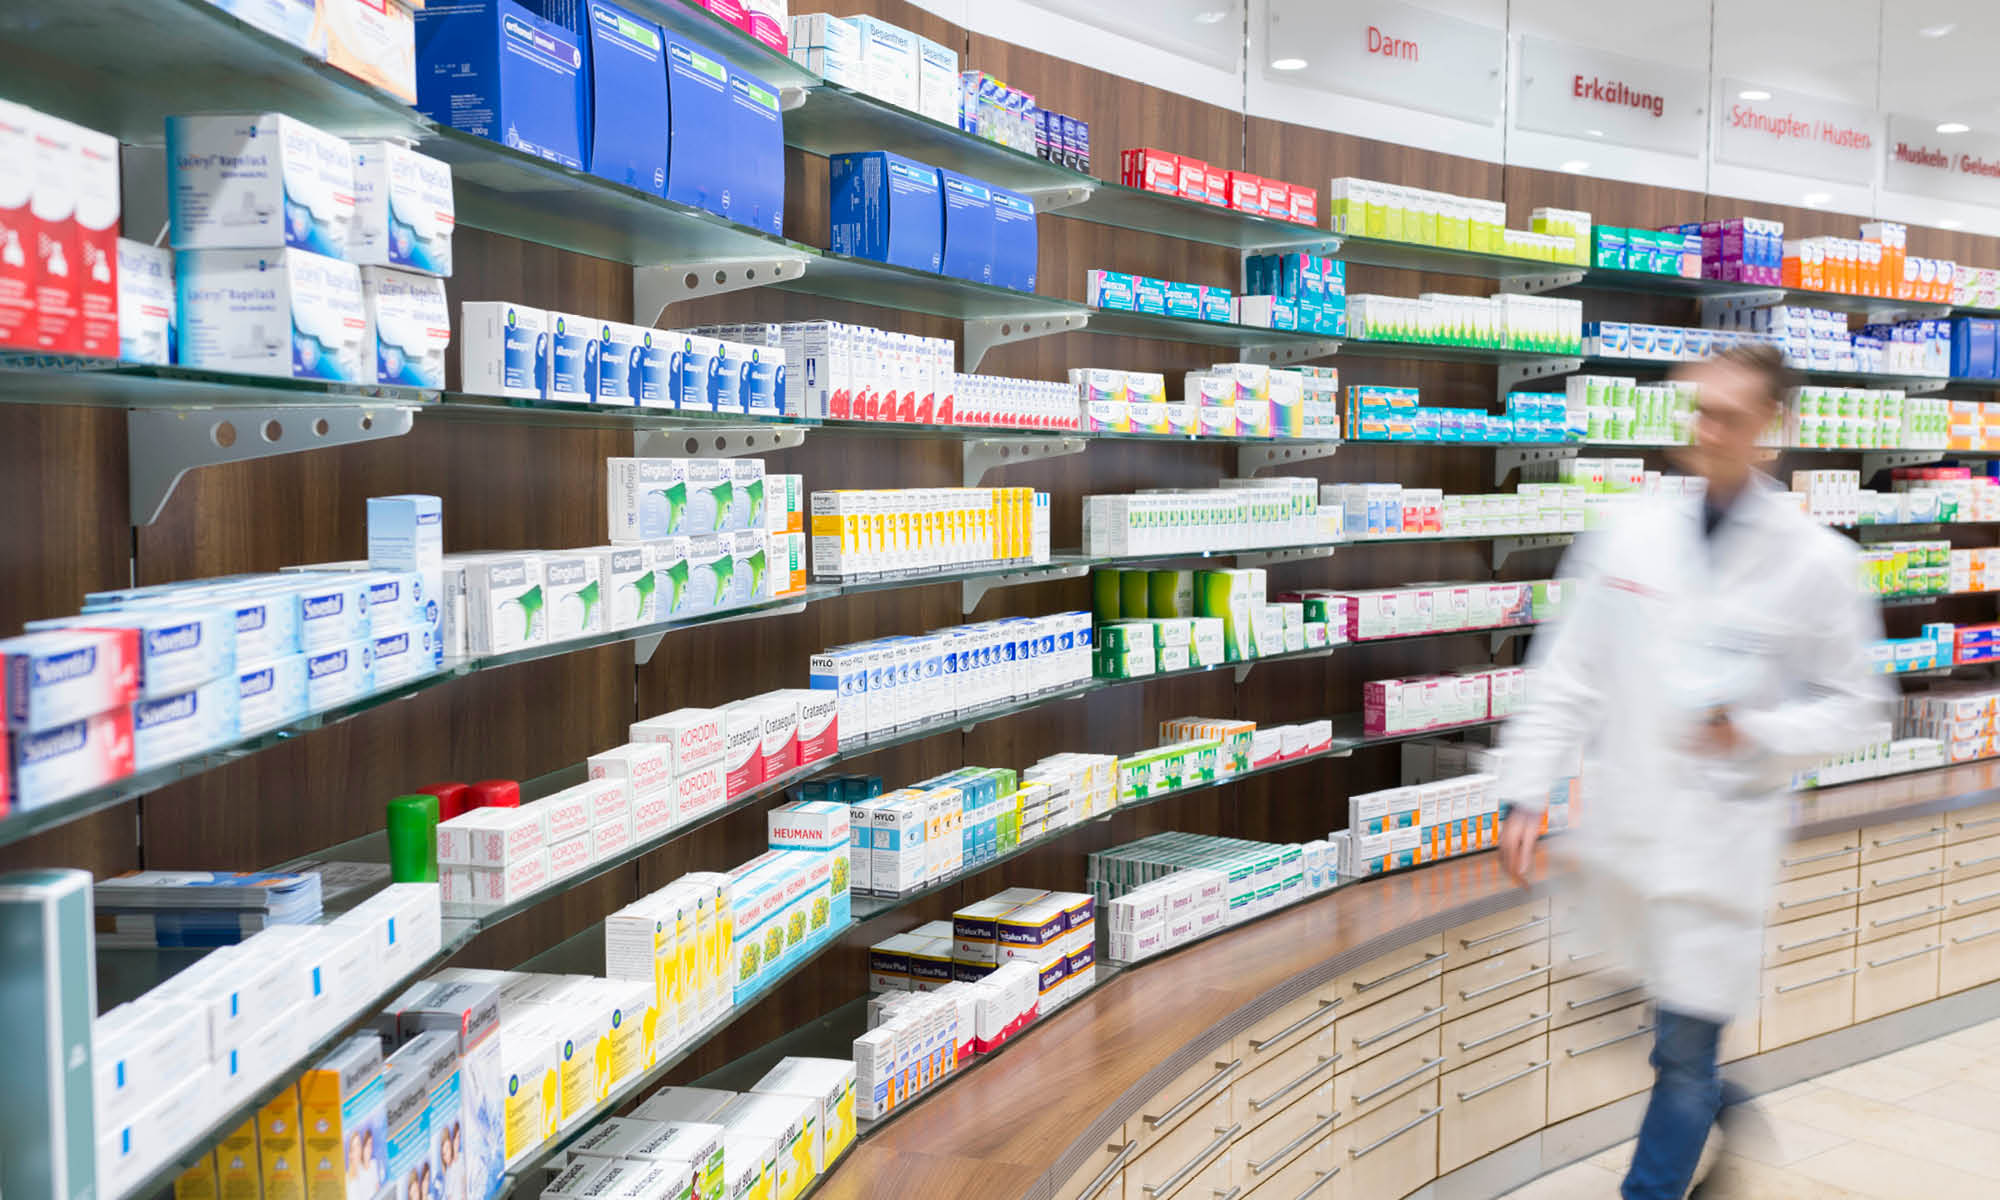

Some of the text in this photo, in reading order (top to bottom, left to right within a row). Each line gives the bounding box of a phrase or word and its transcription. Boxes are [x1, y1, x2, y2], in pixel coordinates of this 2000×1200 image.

[870, 24, 908, 48] Bepanthen
[1368, 26, 1418, 62] Darm
[1574, 75, 1664, 118] Erkältung
[1732, 104, 1809, 140] Schnupfen
[1823, 120, 1870, 149] Husten
[1896, 142, 1949, 169] Muskeln
[812, 659, 833, 667] HYLO
[803, 701, 836, 720] Crataegutt
[680, 721, 718, 748] KORODIN
[765, 713, 796, 735] Crataegutt
[679, 768, 717, 797] KORODIN
[850, 811, 865, 820] YLO
[874, 813, 895, 822] HYLO
[774, 828, 823, 840] HEUMANN
